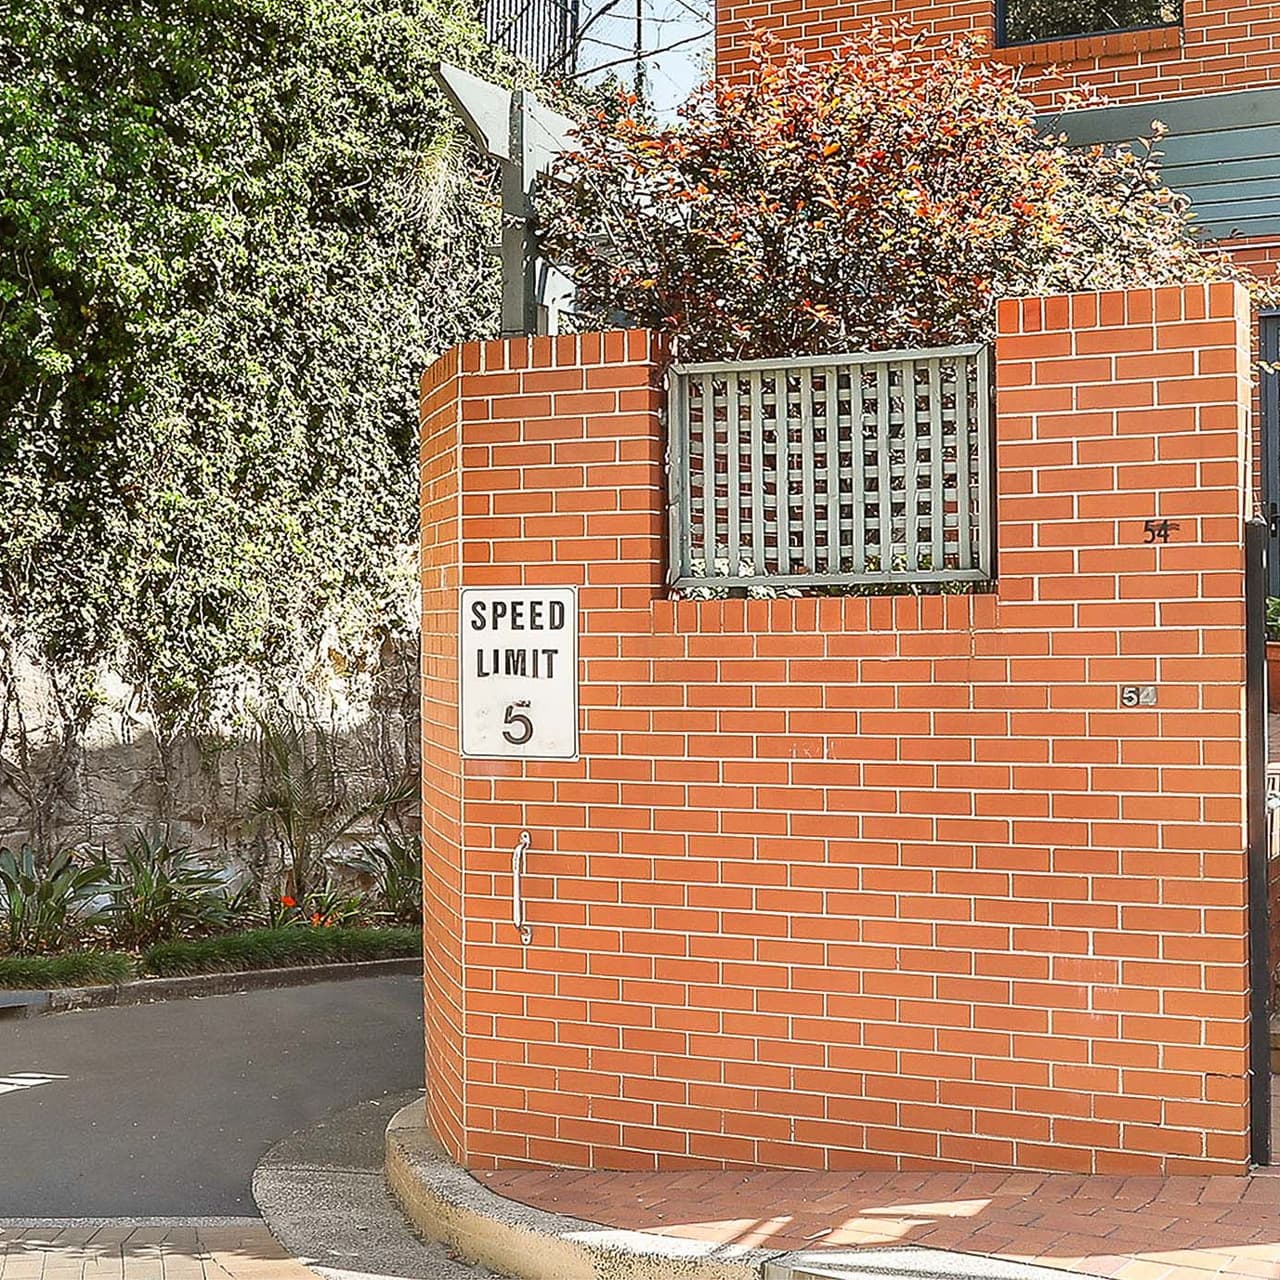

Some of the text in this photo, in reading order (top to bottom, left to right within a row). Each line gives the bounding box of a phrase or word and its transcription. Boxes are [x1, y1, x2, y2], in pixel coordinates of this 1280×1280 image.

[1144, 520, 1169, 544] 54
[471, 601, 565, 631] SPEED
[477, 649, 559, 679] LIMIT
[502, 699, 534, 745] 5
